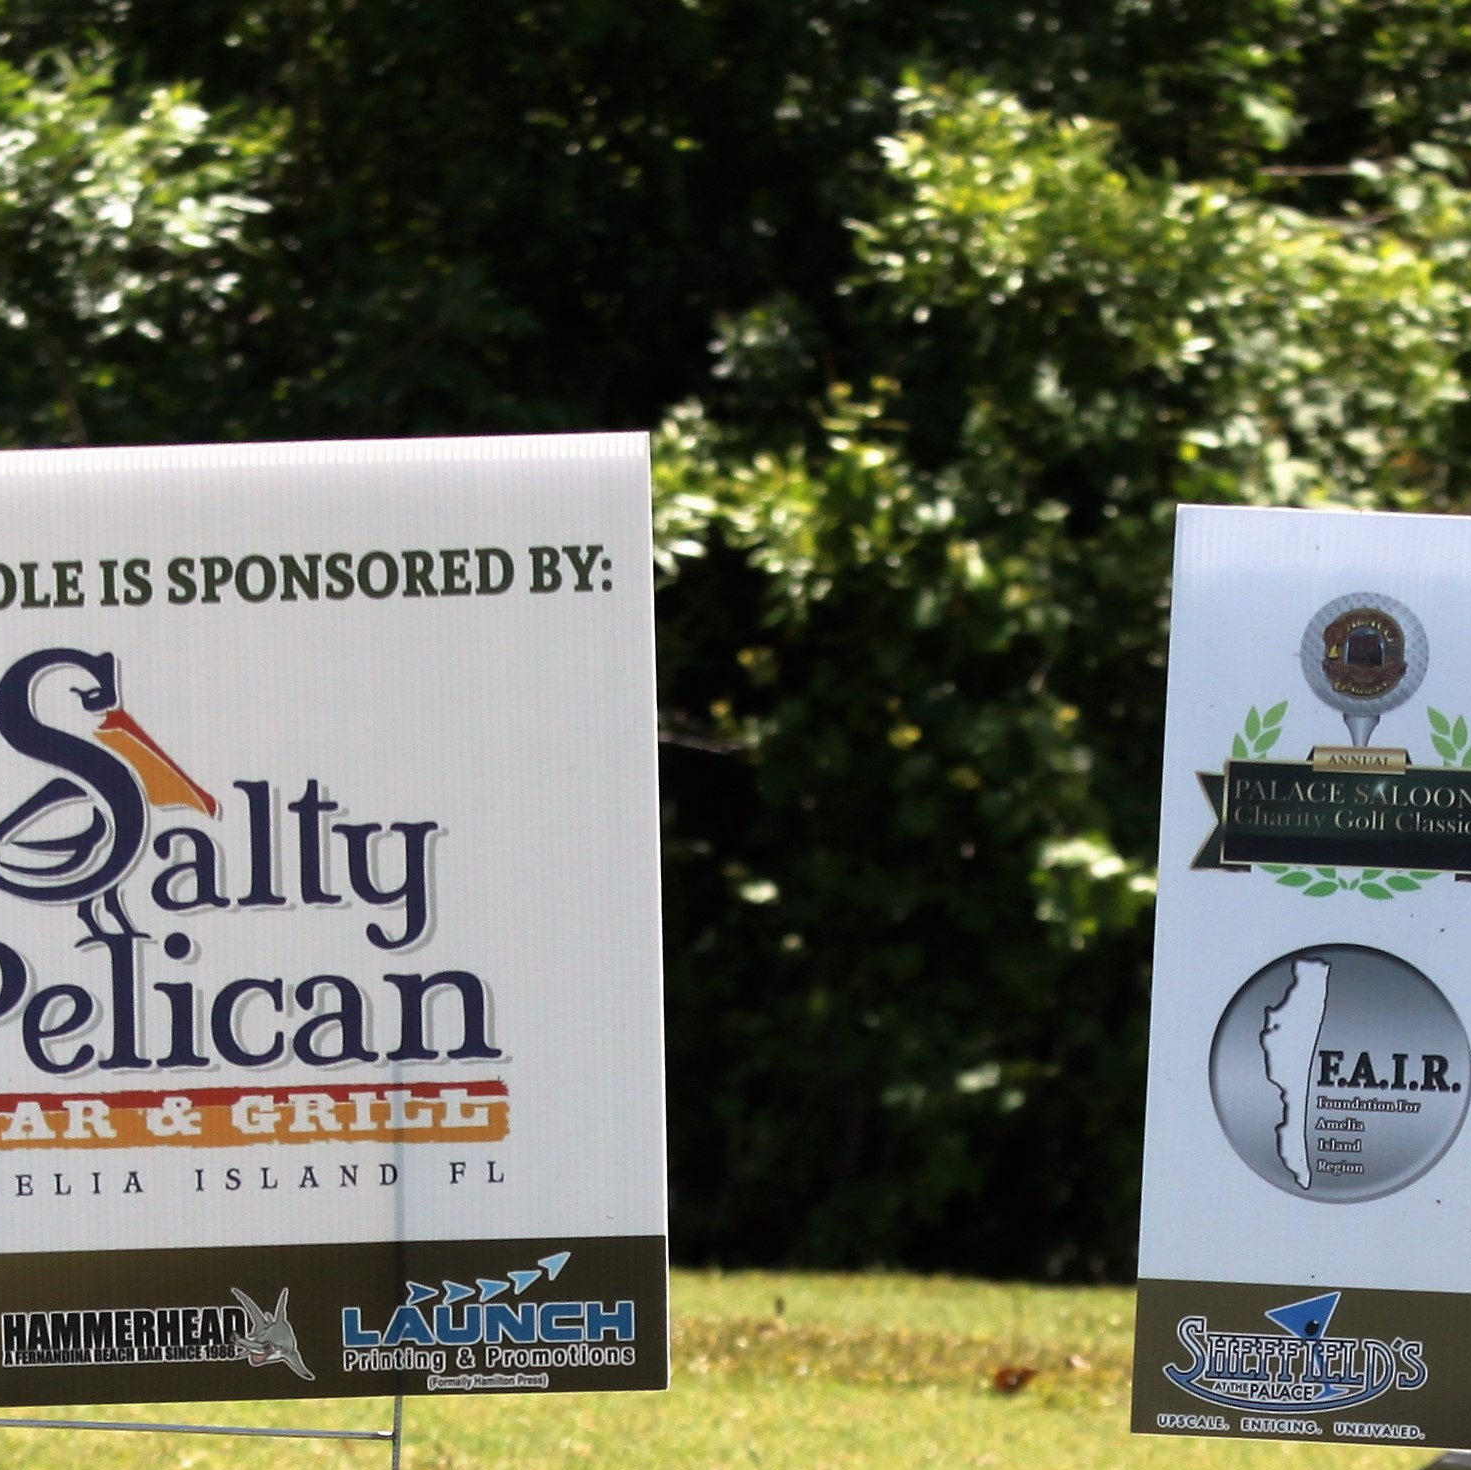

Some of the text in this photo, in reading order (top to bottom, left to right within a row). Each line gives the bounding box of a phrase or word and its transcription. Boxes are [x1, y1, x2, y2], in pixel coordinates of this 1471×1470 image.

[100, 558, 154, 607] IS
[167, 547, 514, 605] SPONSORED
[528, 545, 614, 594] BY:
[1327, 753, 1393, 767] ANNUAL
[1235, 778, 1345, 804] PALACE
[1235, 806, 1326, 834] Charity
[1334, 808, 1388, 831] Golf
[1317, 1050, 1461, 1093] F.A.I.R.
[146, 1095, 203, 1138] &
[231, 1088, 490, 1135] GRILL
[1317, 1096, 1421, 1113] Foundation For
[1315, 1117, 1365, 1132] Amelia
[1318, 1138, 1362, 1152] Island
[195, 1163, 400, 1192] ISLAND
[450, 1160, 505, 1186] FL
[1317, 1160, 1364, 1176] Region
[2, 1307, 247, 1350] HAMMERHEAD
[342, 1301, 634, 1347] LAUNCH
[4, 1350, 15, 1365] A
[16, 1349, 92, 1364] FERNANDINA
[95, 1348, 134, 1362] BEACH
[137, 1346, 162, 1361] BAR
[165, 1346, 202, 1360] SINCE
[343, 1344, 635, 1372] Printing & Promotions
[1250, 1384, 1314, 1400] PALACE
[1158, 1414, 1425, 1439] UPSCALE. ENTICING. UNRIVALED.
